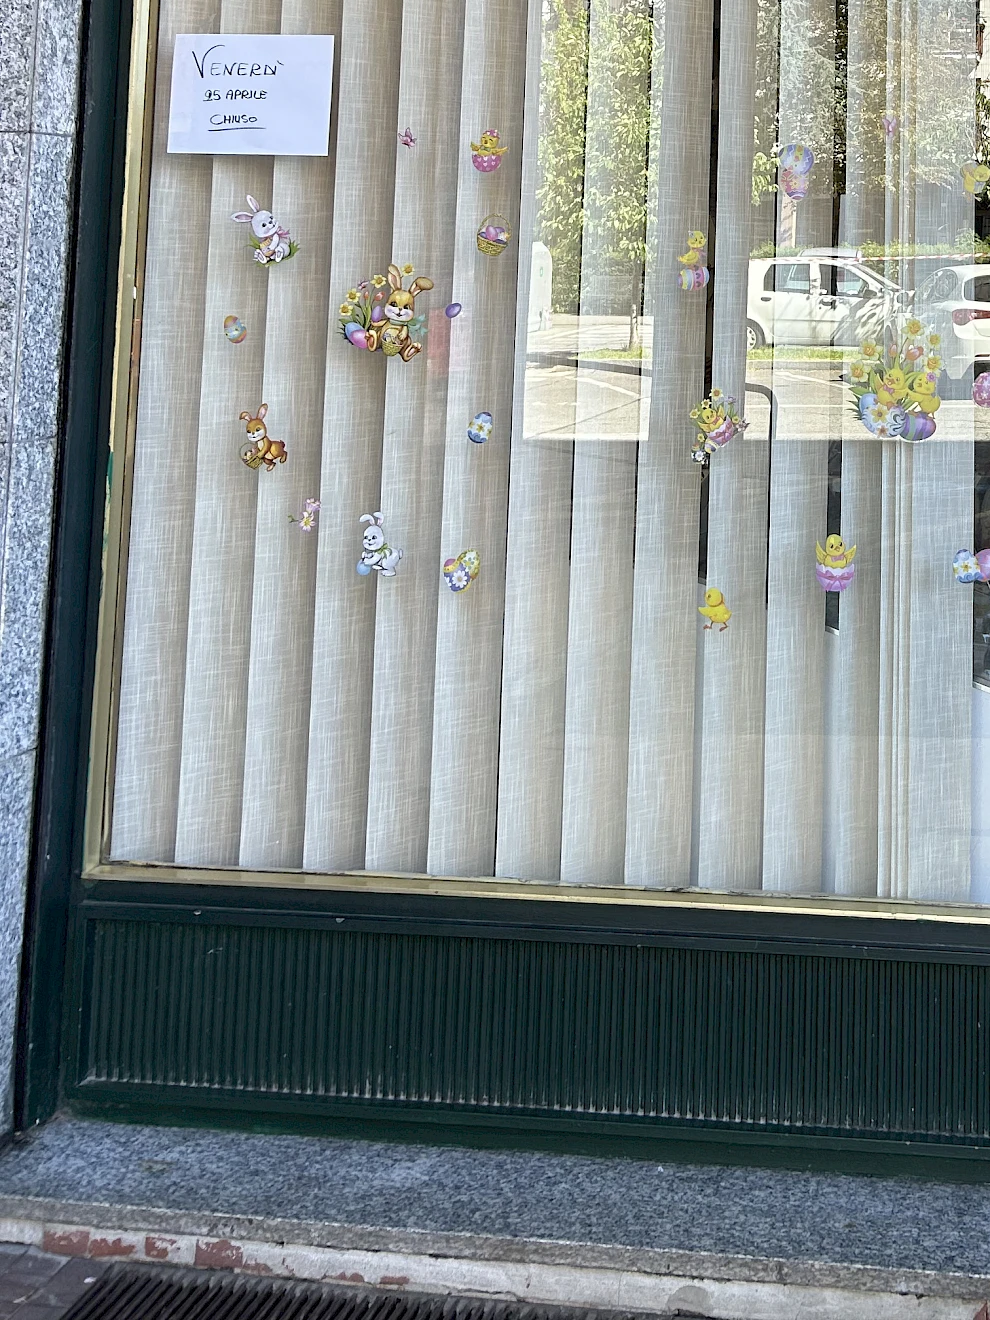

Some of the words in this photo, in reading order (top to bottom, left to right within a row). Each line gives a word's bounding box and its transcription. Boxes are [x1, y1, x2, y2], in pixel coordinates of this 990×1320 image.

[203, 89, 222, 101] 25
[225, 89, 268, 101] APRILE
[209, 113, 258, 126] CHIUSO
